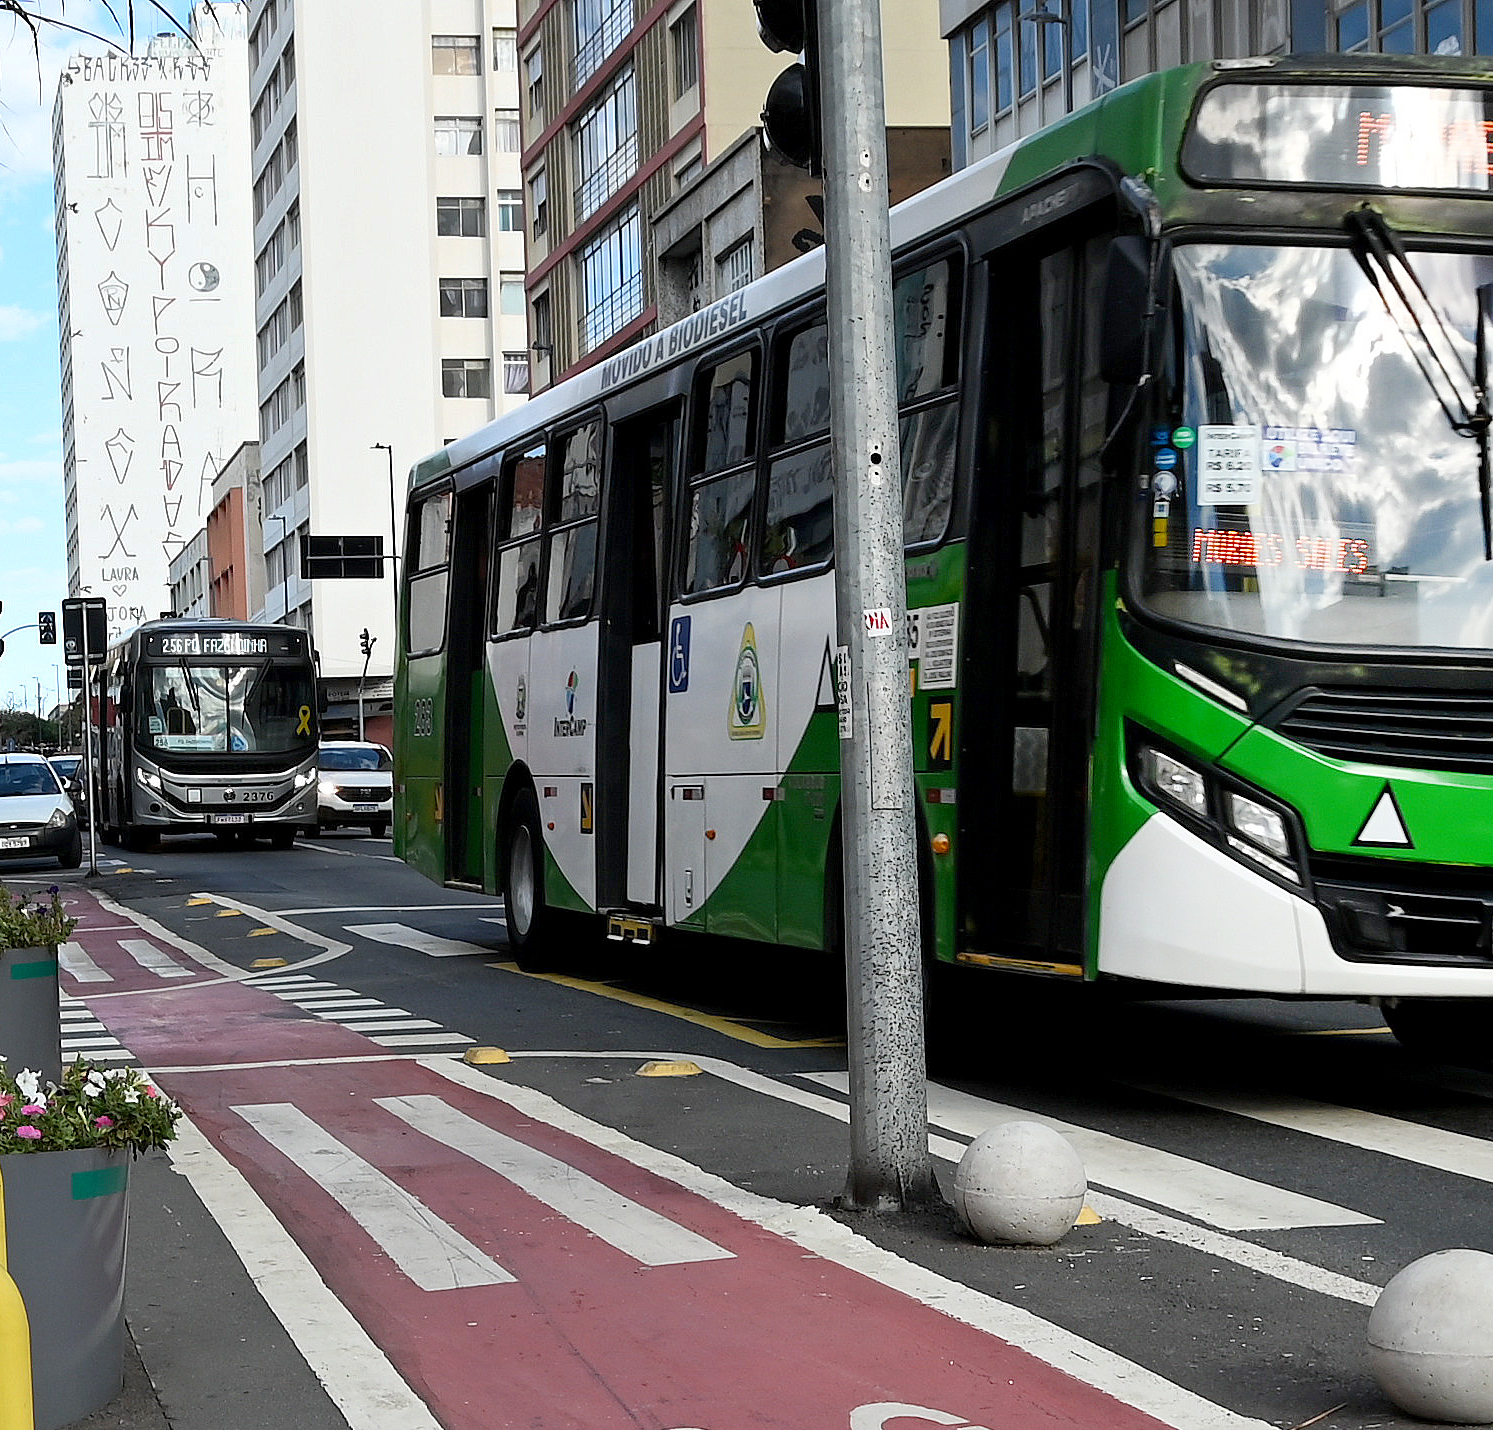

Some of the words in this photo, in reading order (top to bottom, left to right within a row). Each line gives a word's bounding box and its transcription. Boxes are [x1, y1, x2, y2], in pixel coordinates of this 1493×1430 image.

[601, 341, 652, 390] MOVIDO
[655, 337, 664, 363] A
[668, 290, 748, 357] BIODIESEL
[163, 638, 183, 653] 256
[243, 791, 274, 802] 2376
